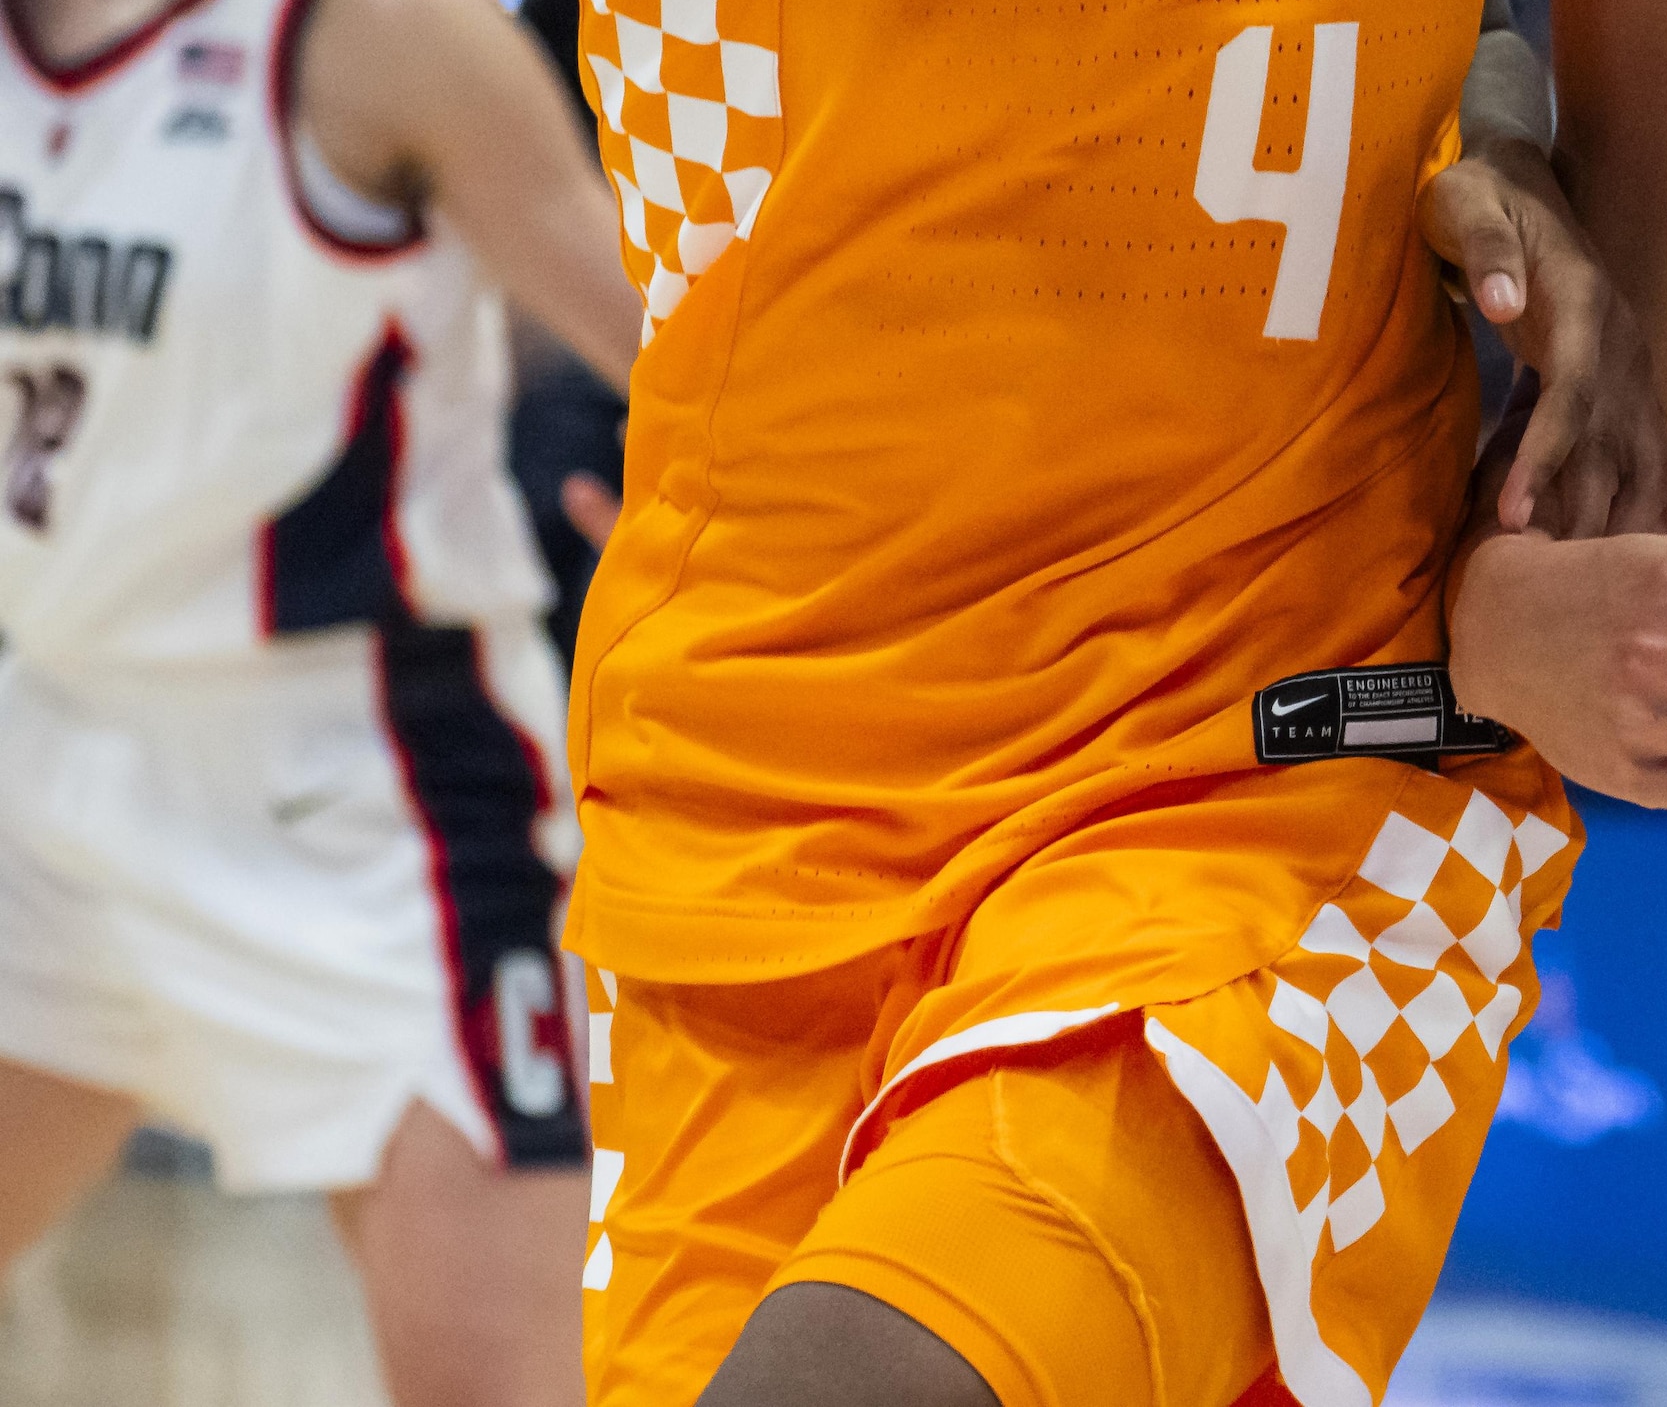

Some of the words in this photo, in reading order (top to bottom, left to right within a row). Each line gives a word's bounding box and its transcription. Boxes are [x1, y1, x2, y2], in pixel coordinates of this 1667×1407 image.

[1193, 21, 1360, 342] 4
[1346, 675, 1432, 692] ENGINEERED
[1272, 725, 1332, 739] TEAM
